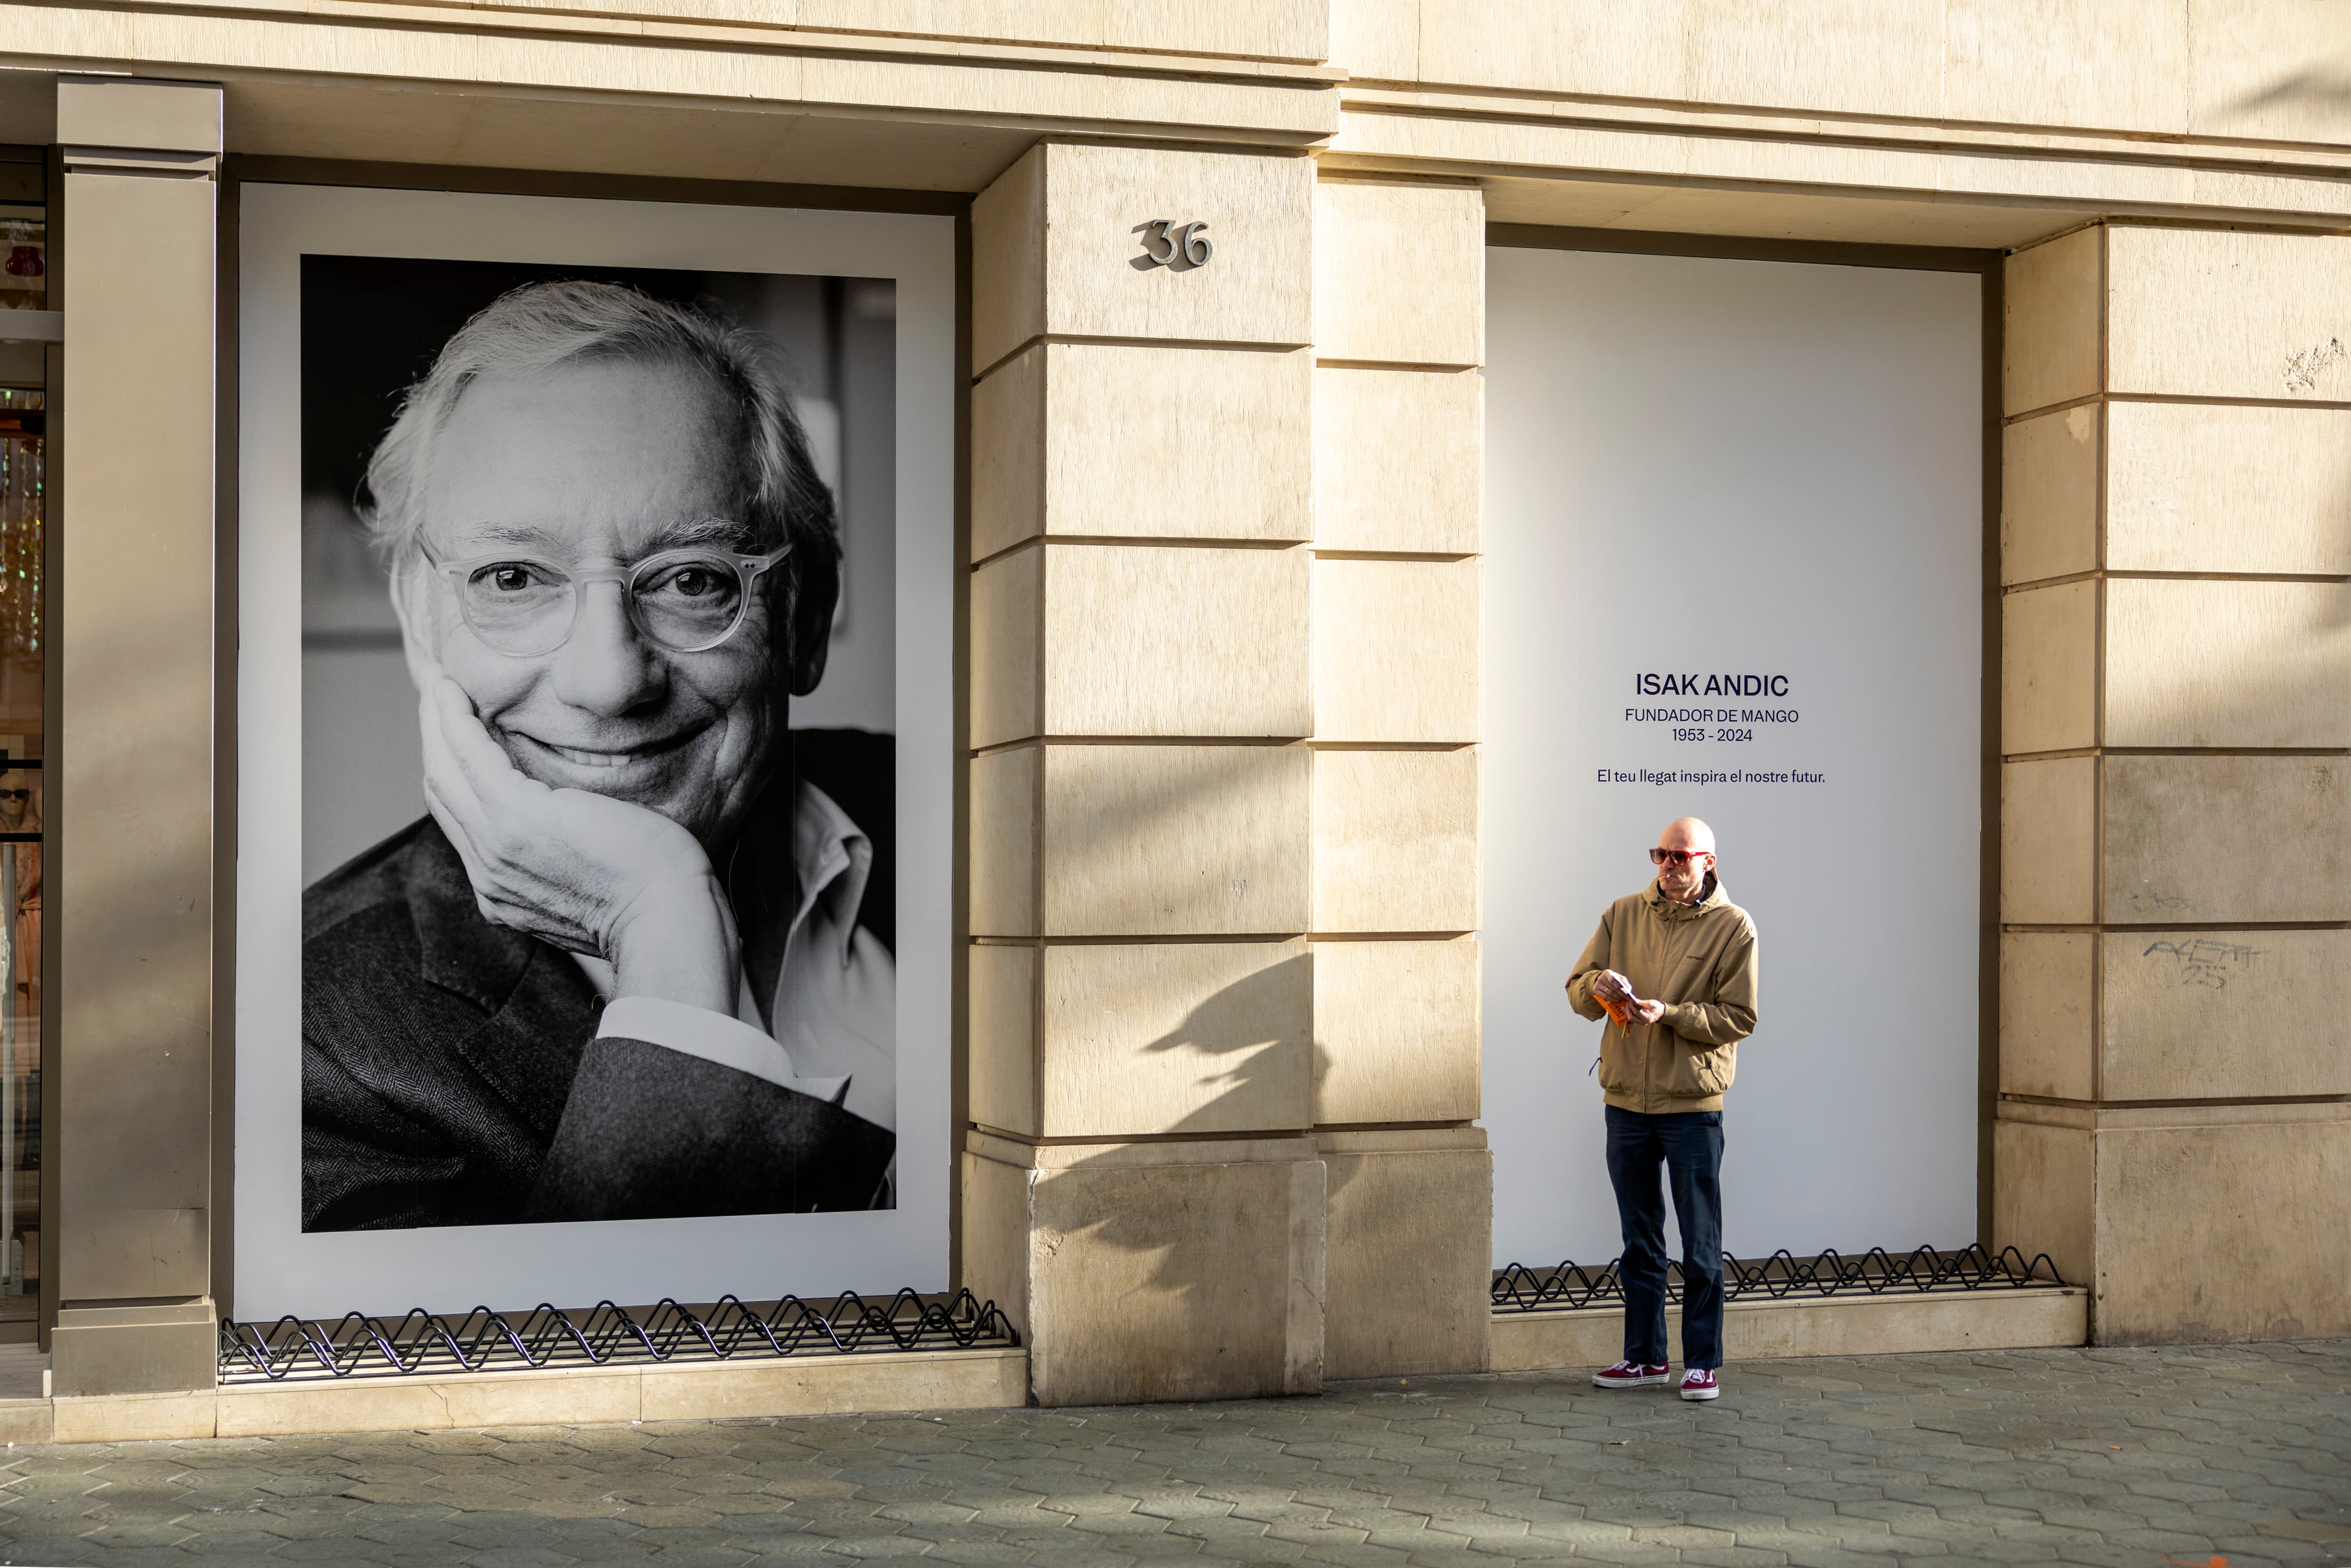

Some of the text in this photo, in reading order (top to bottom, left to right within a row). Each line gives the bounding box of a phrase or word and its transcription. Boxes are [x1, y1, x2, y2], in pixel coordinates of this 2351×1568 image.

[1149, 219, 1213, 266] 36
[1637, 674, 1788, 697] ISAK ANDIC
[1626, 709, 1798, 722] FUNDADOR DE MANGO
[1673, 729, 1704, 741] 1953
[1718, 729, 1753, 741] 2024
[1598, 769, 1825, 786] El teu llegat inspira el nostre futur.
